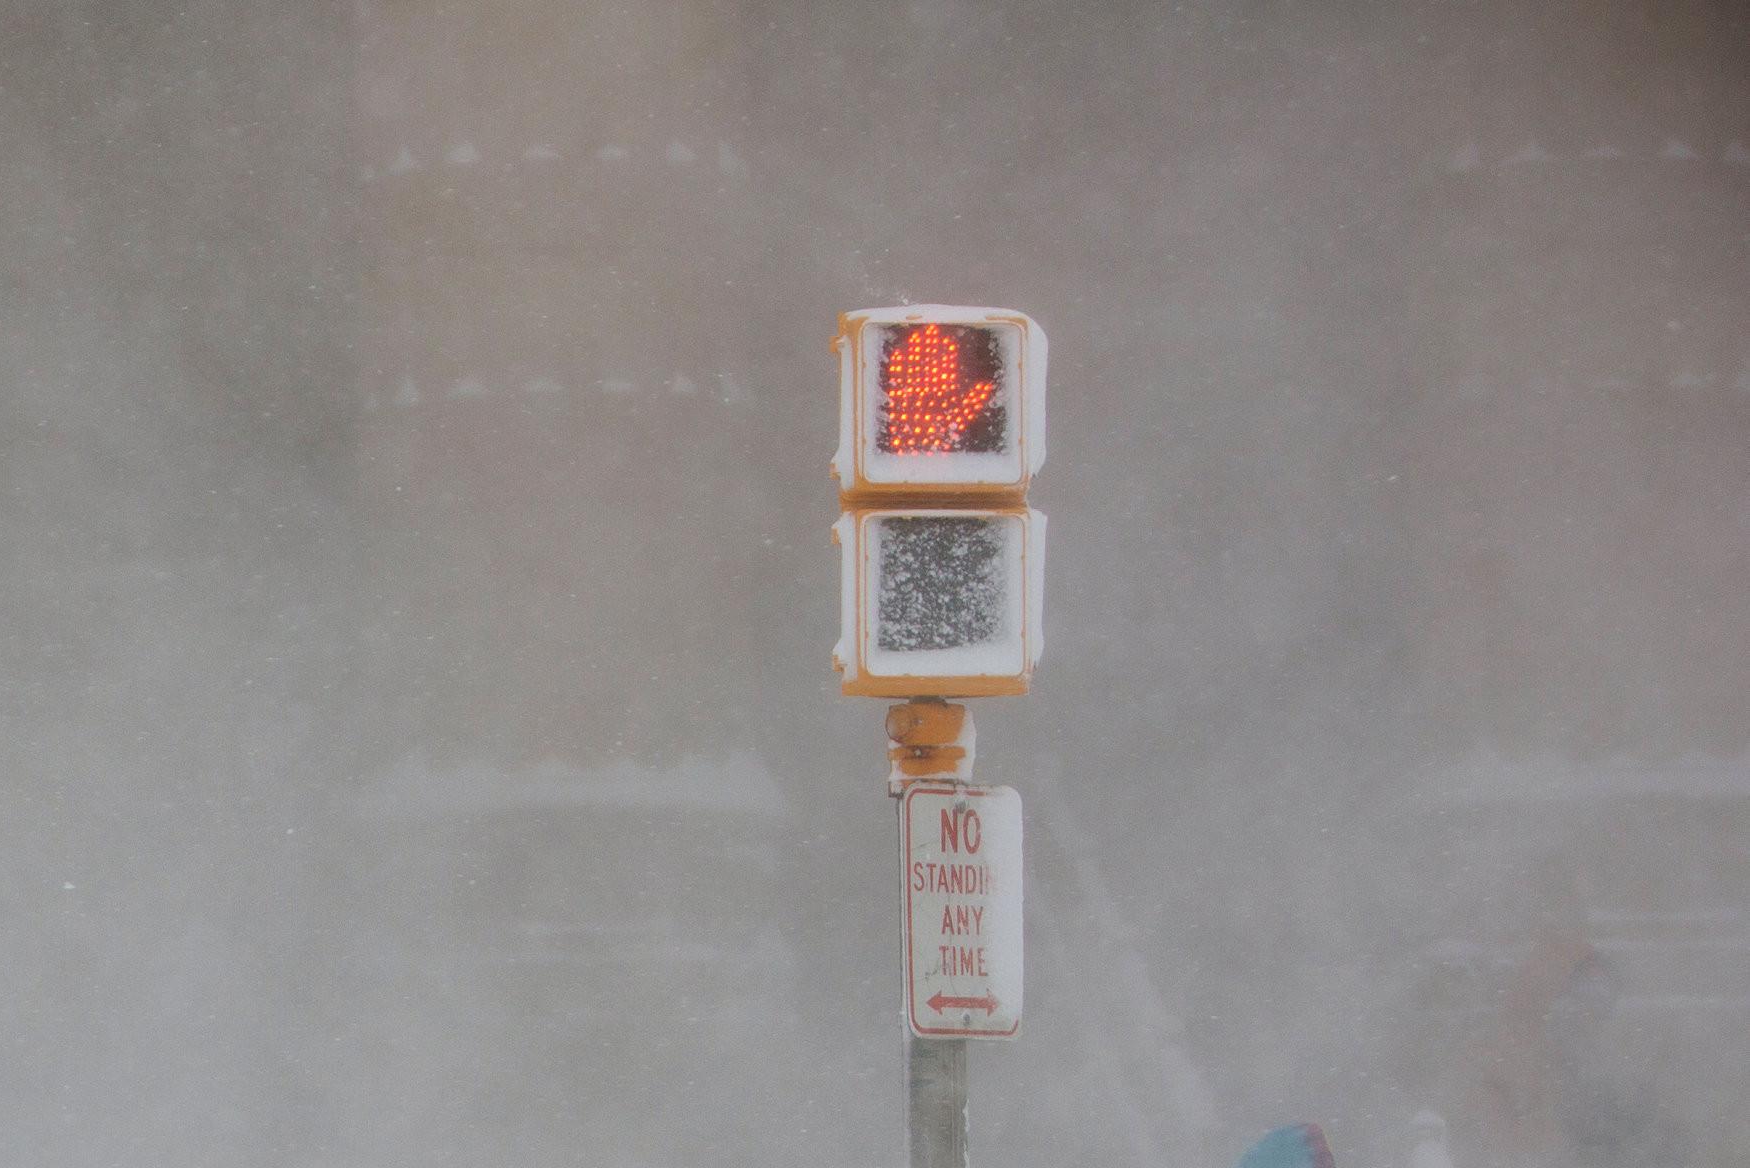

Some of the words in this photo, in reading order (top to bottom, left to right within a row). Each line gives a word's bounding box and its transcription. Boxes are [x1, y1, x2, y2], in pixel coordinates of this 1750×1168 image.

[940, 808, 981, 854] NO
[913, 861, 996, 896] STANDI
[941, 904, 984, 936] ANY
[938, 945, 989, 977] TIME
